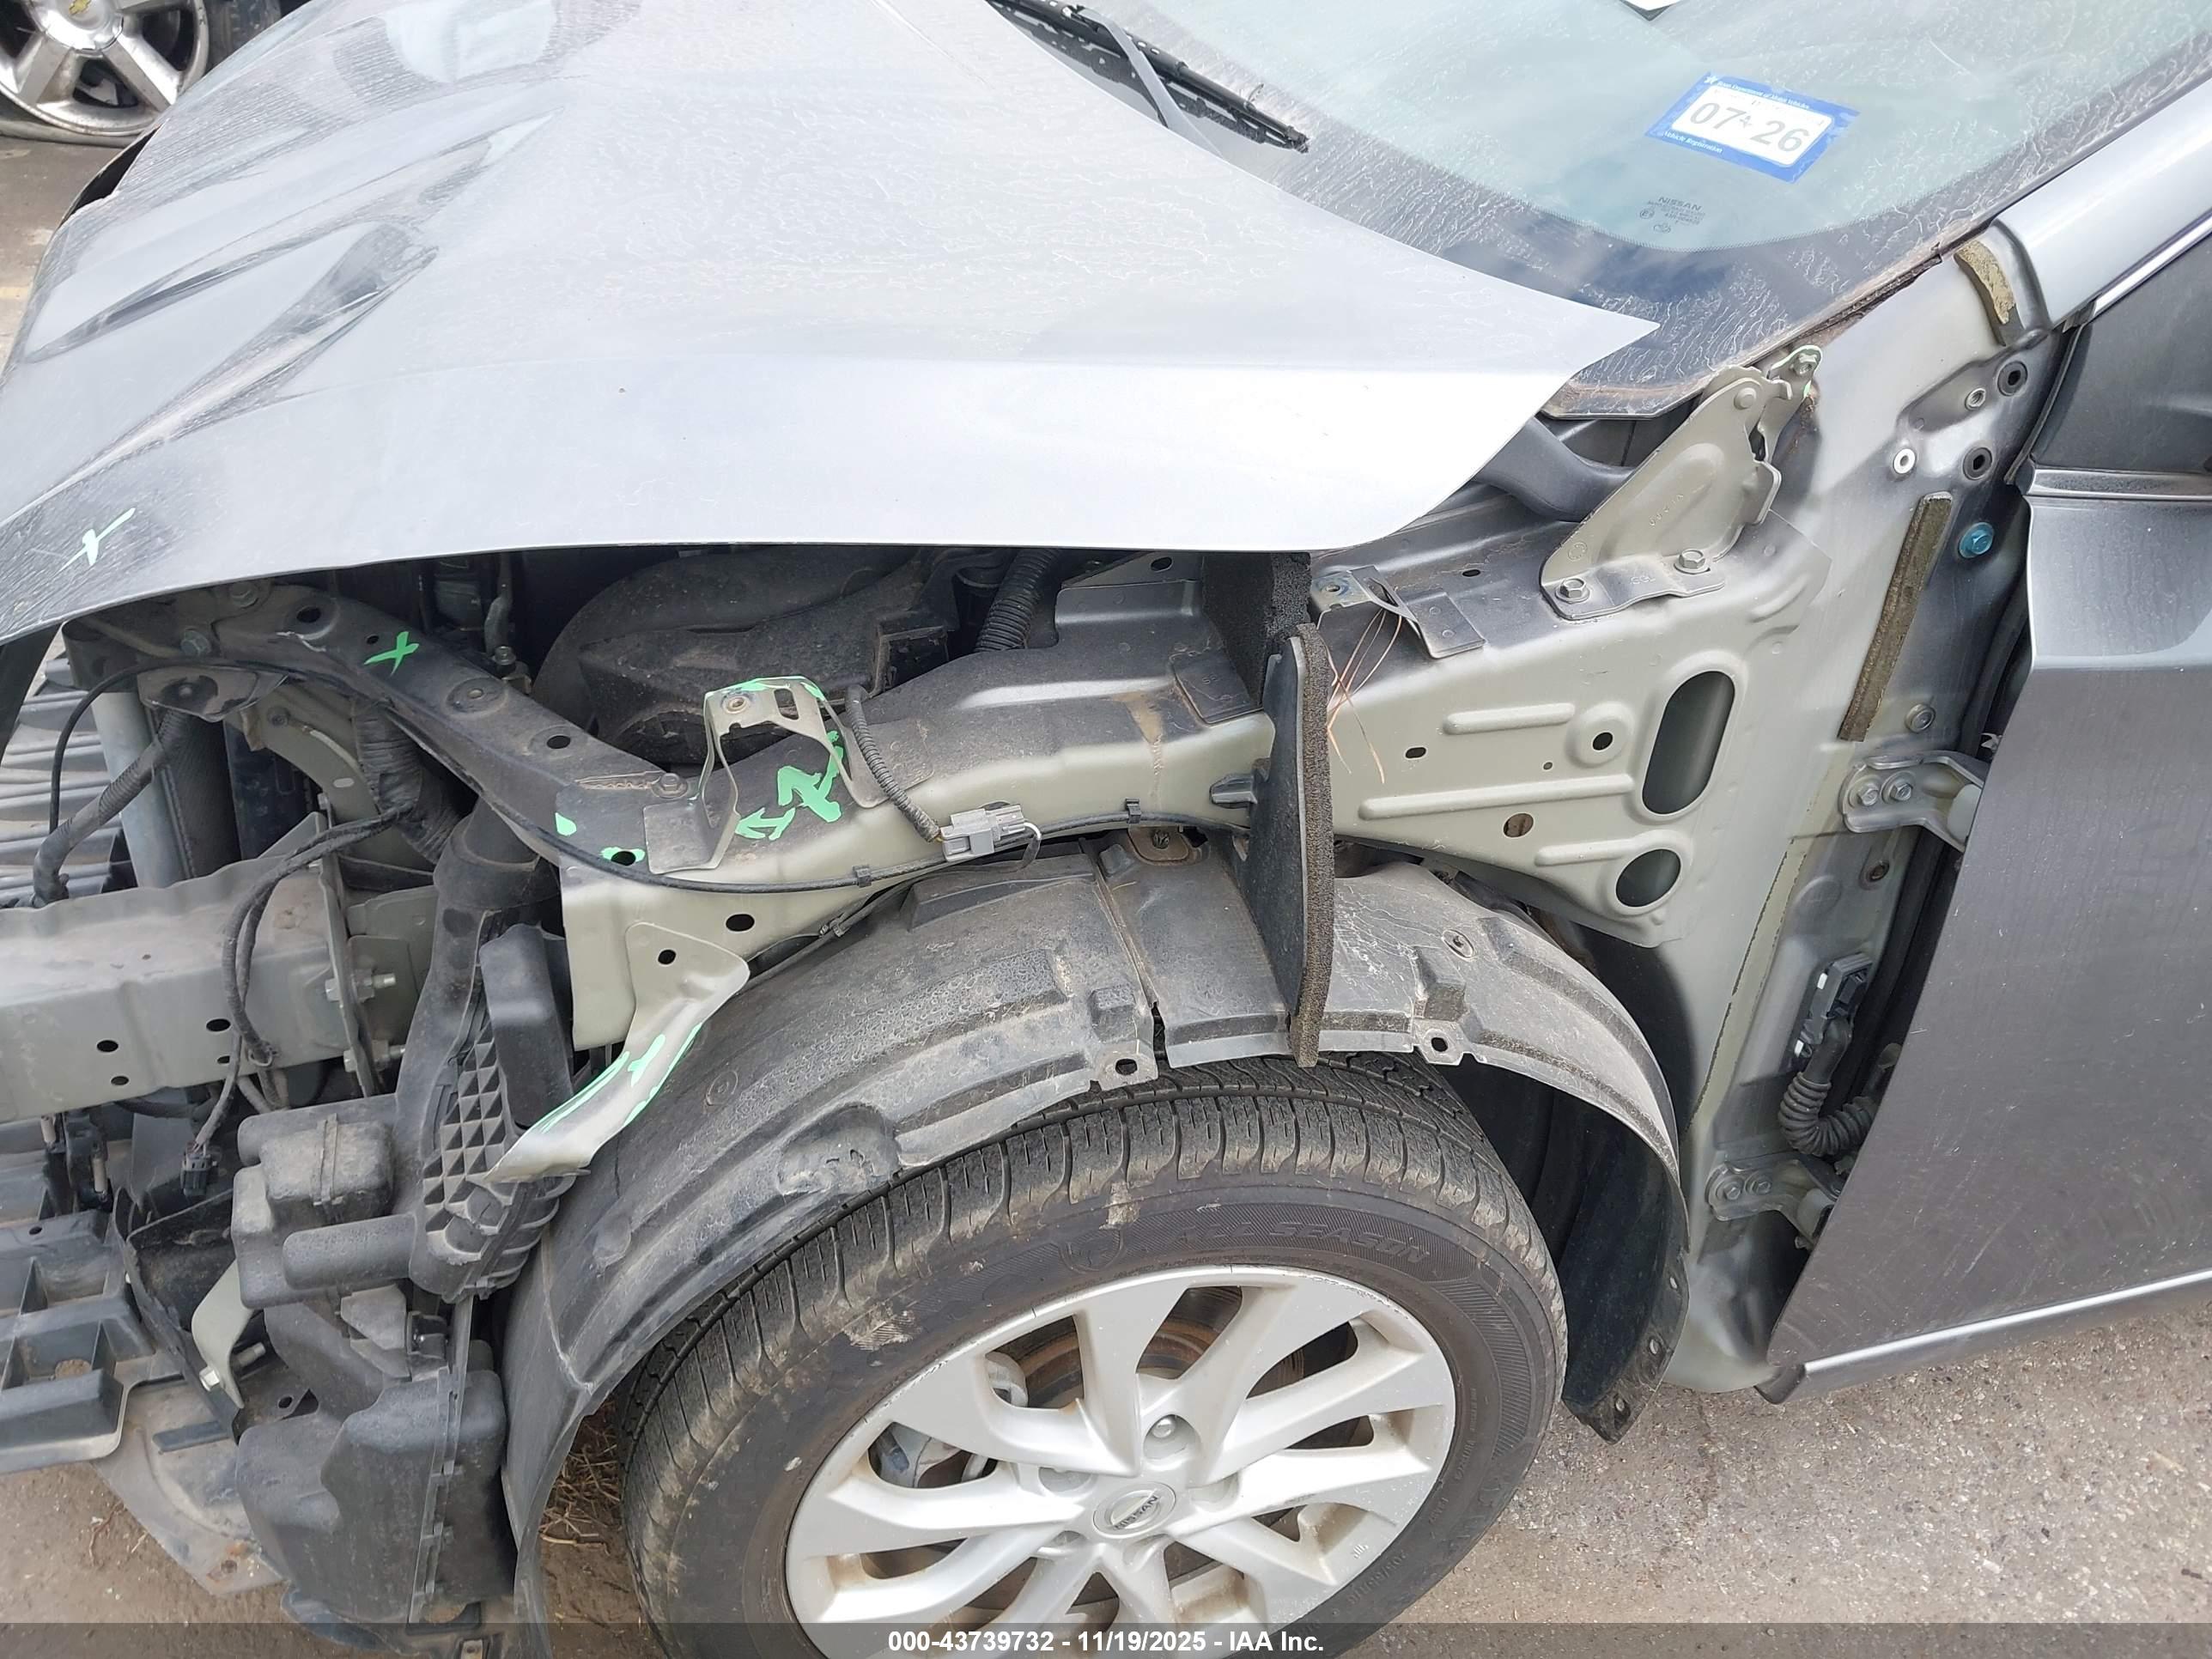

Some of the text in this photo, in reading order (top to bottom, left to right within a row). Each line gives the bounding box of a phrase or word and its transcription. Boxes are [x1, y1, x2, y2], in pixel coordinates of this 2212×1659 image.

[1690, 102, 1747, 130] 07
[1750, 120, 1810, 152] 26
[1658, 197, 1702, 211] NISSAN
[1171, 1220, 1431, 1263] ALL SEASON
[1113, 1494, 1159, 1530] NISSAN
